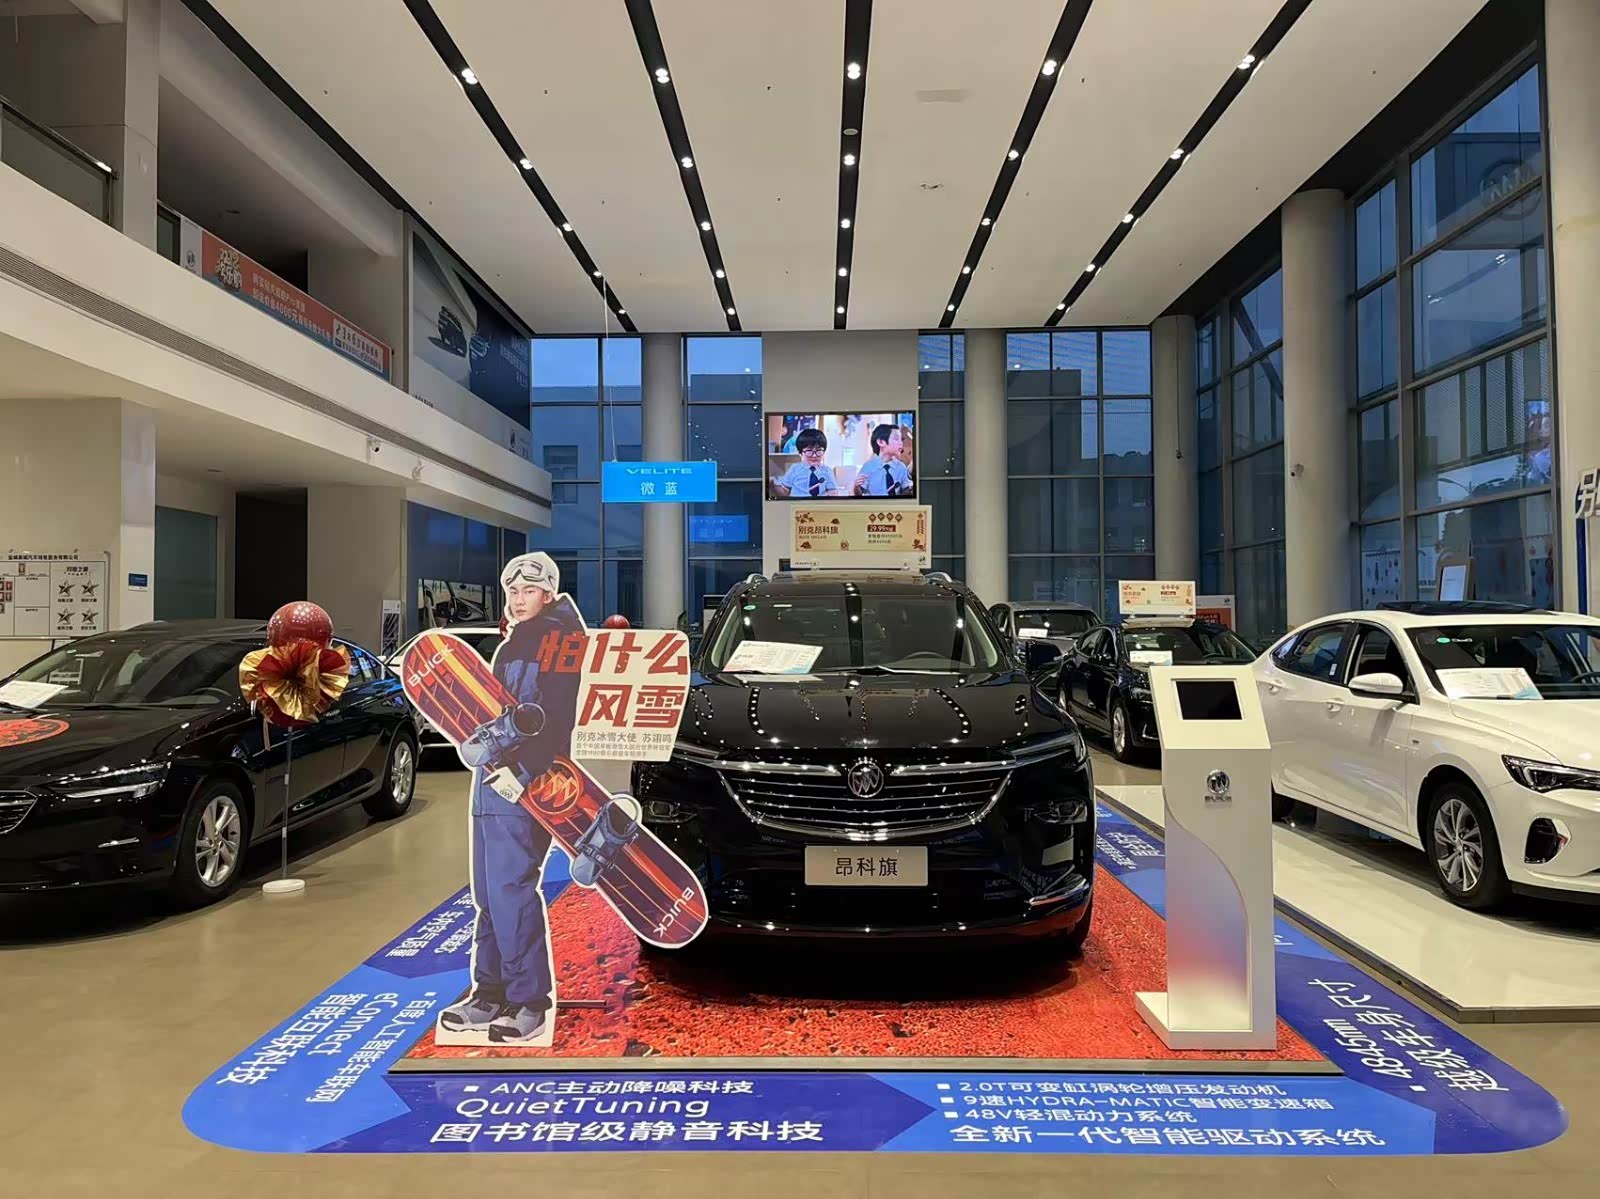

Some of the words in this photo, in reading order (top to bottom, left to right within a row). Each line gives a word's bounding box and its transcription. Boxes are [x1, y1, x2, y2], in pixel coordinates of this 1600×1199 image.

[626, 467, 693, 475] VELITE
[798, 525, 839, 534] 别克昂科旗
[537, 630, 690, 677] 怕什么
[408, 643, 454, 687] BUICK
[578, 684, 685, 729] 风雪
[576, 731, 637, 743] 别克冰雪大使
[643, 733, 672, 743] 苏翊鸣
[835, 857, 898, 877] 昂科旗
[653, 887, 695, 938] BUICK
[307, 992, 399, 1056] eConnect
[216, 992, 368, 1085] 智能互联科技
[1307, 978, 1510, 1092] 越级车身尺寸
[305, 998, 440, 1103] 百度人工智能车联网
[1322, 1018, 1413, 1079] 4845mm
[489, 1080, 754, 1095] ANC主动降噪科技
[959, 1080, 1286, 1097] 2.0T可变缸涡轮增压发动机
[455, 1097, 710, 1118] QuietTuning
[963, 1095, 1334, 1111] 9速HYDRA-MATIC智能变速箱
[964, 1108, 1199, 1124] 48V轻混动力系统
[429, 1121, 824, 1143] 图书馆级静音科技
[949, 1126, 1387, 1147] 全新一代智能驱动系统
